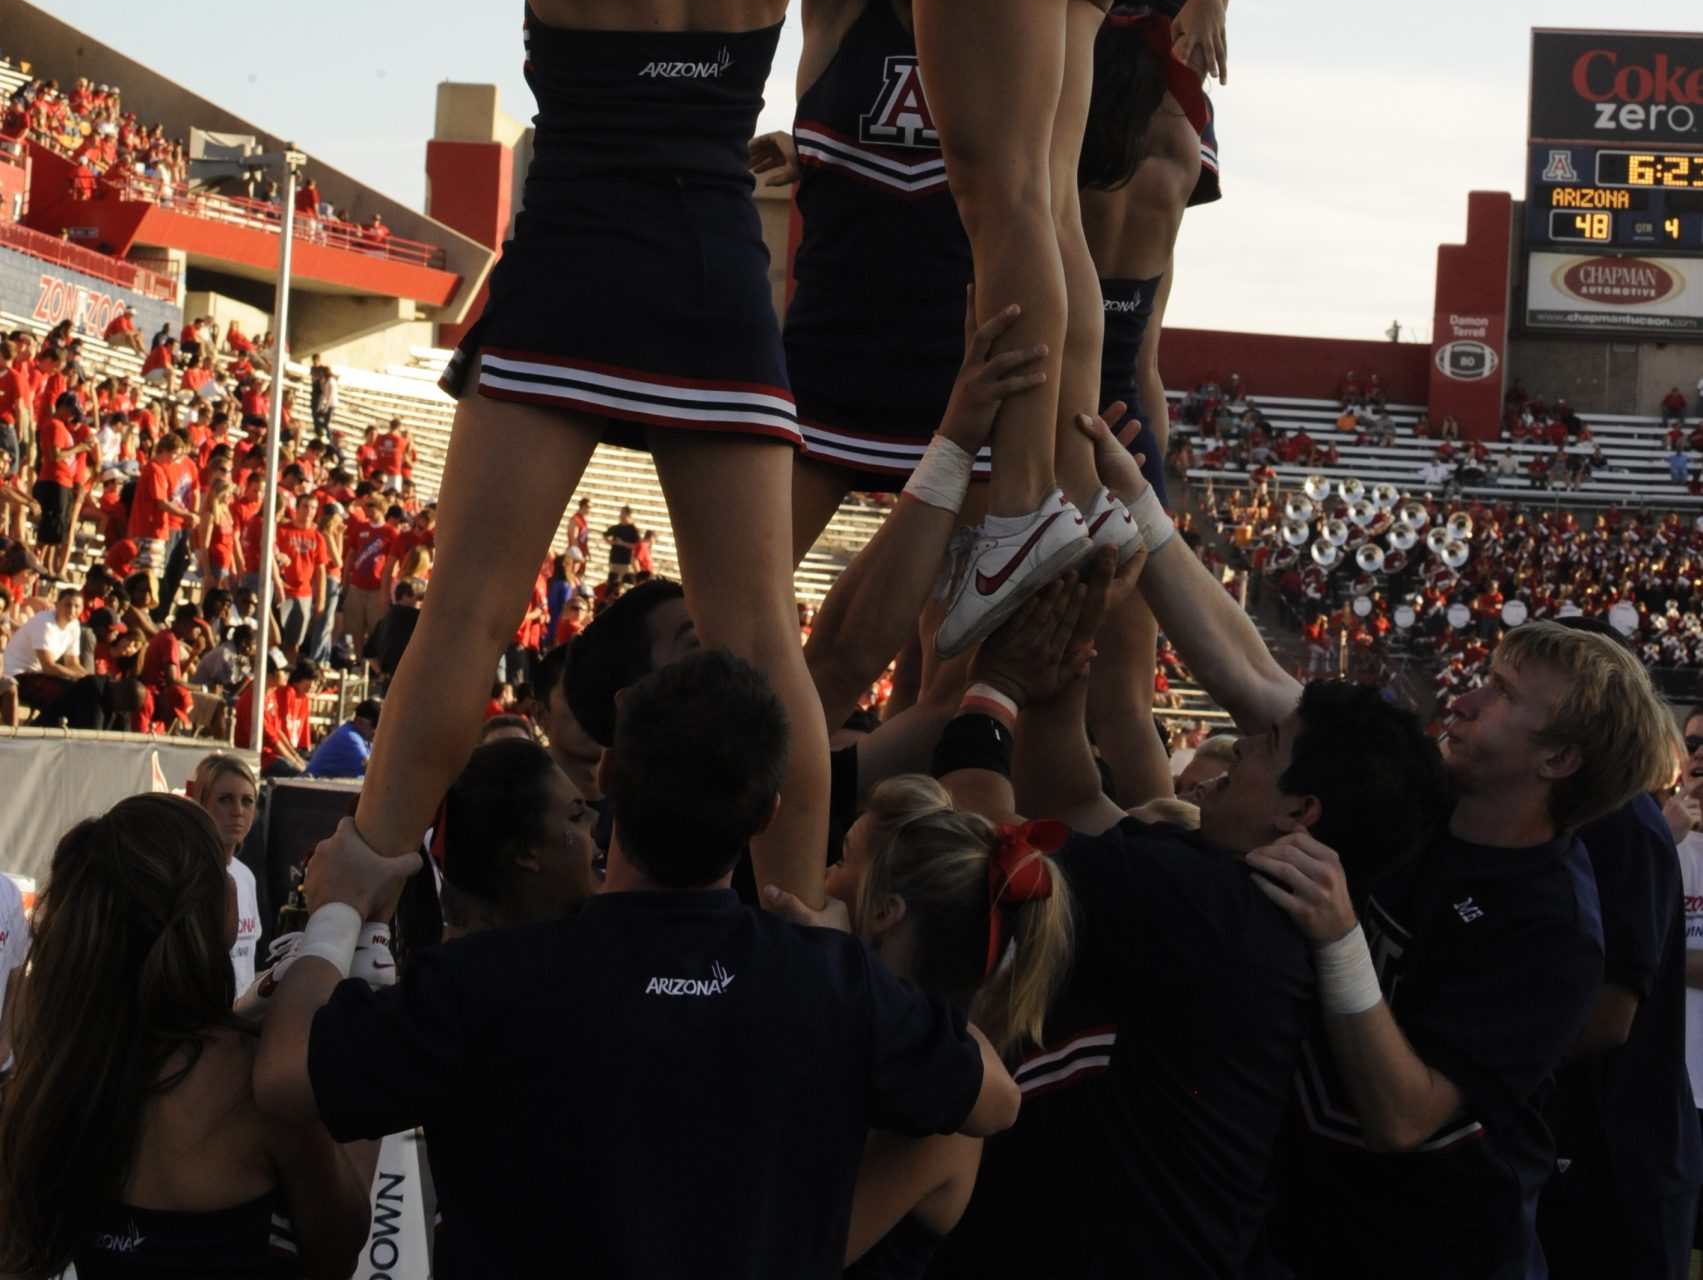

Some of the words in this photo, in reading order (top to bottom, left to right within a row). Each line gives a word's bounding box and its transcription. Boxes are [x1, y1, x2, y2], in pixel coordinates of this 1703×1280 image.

[637, 61, 719, 79] ARIZONA
[1593, 103, 1695, 132] zero
[1551, 187, 1631, 210] ARIZONA
[1575, 213, 1610, 239] 48
[1664, 217, 1681, 240] 4
[1579, 266, 1657, 287] CHAPMAN
[1580, 285, 1657, 298] AUTOMOTIVE
[1536, 312, 1698, 328] www.chapmantucson.com
[645, 976, 723, 996] ARIZONA
